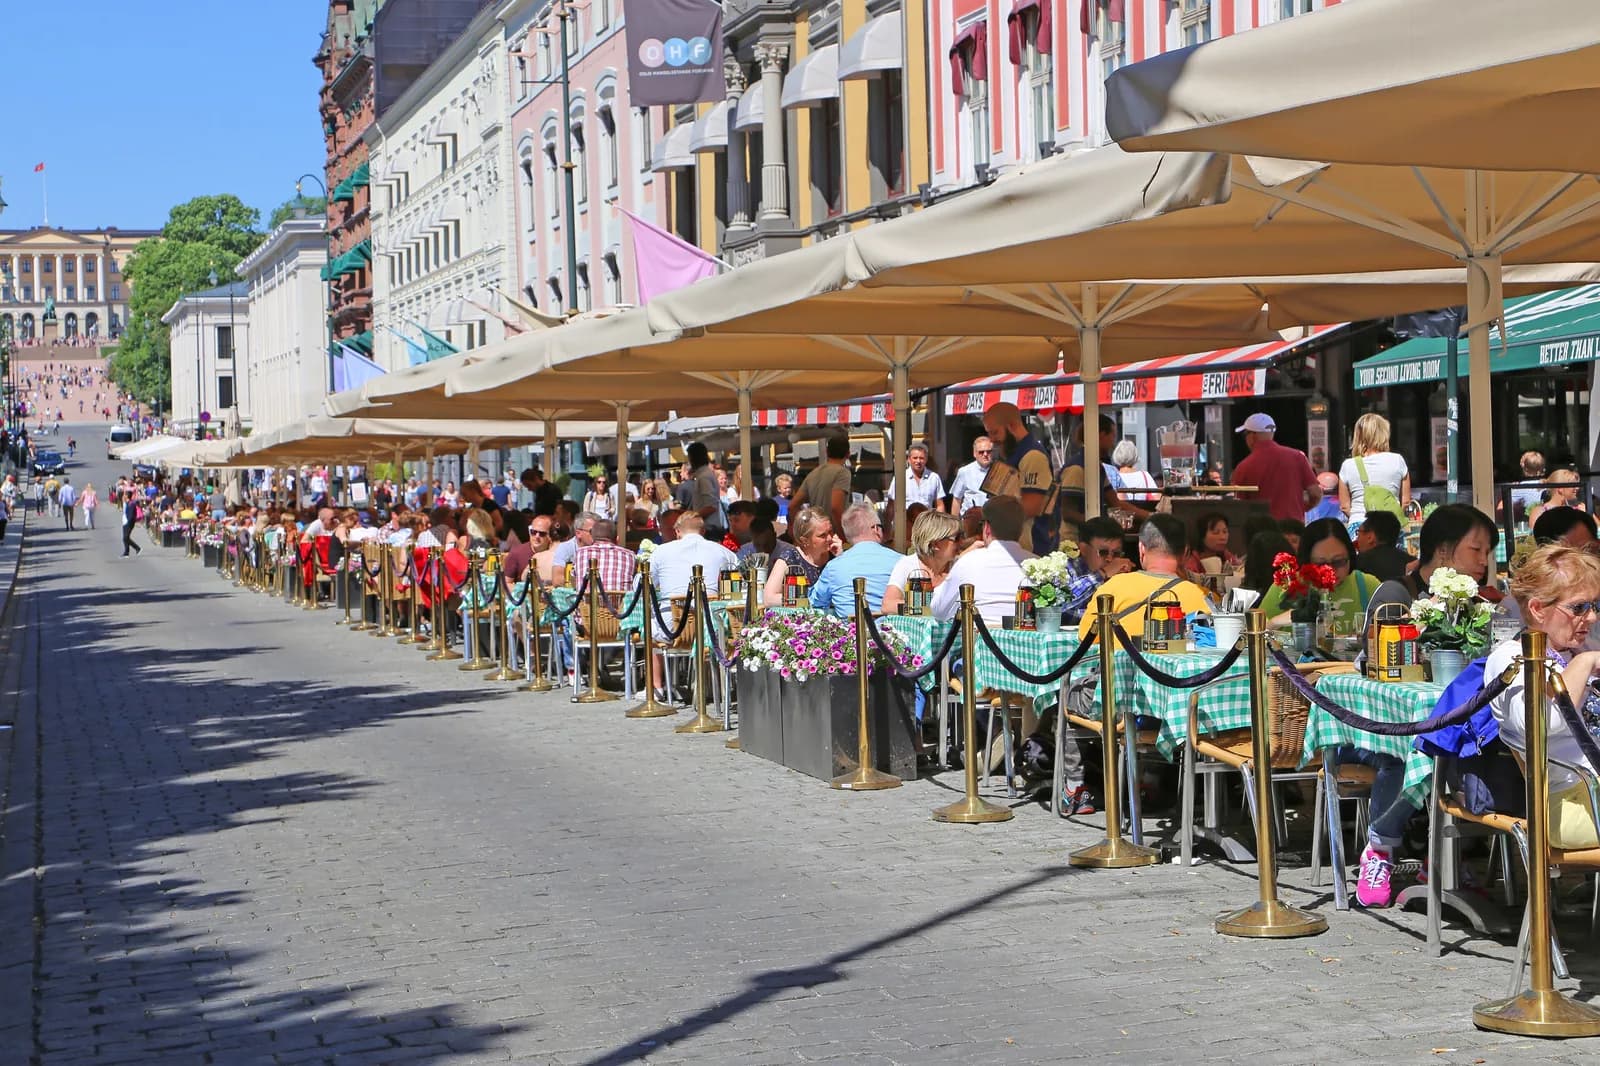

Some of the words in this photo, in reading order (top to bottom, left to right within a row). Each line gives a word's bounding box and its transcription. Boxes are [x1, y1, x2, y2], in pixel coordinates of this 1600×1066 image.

[1540, 341, 1569, 364] BETTER
[1570, 337, 1594, 360] THAN
[1209, 370, 1254, 394] FRIDAYS
[1360, 367, 1375, 387] YOUR
[1375, 364, 1399, 385] SECOND
[1400, 361, 1421, 382] LIVING
[1422, 359, 1440, 379] ROOM
[1111, 379, 1149, 401] FRIDAYS
